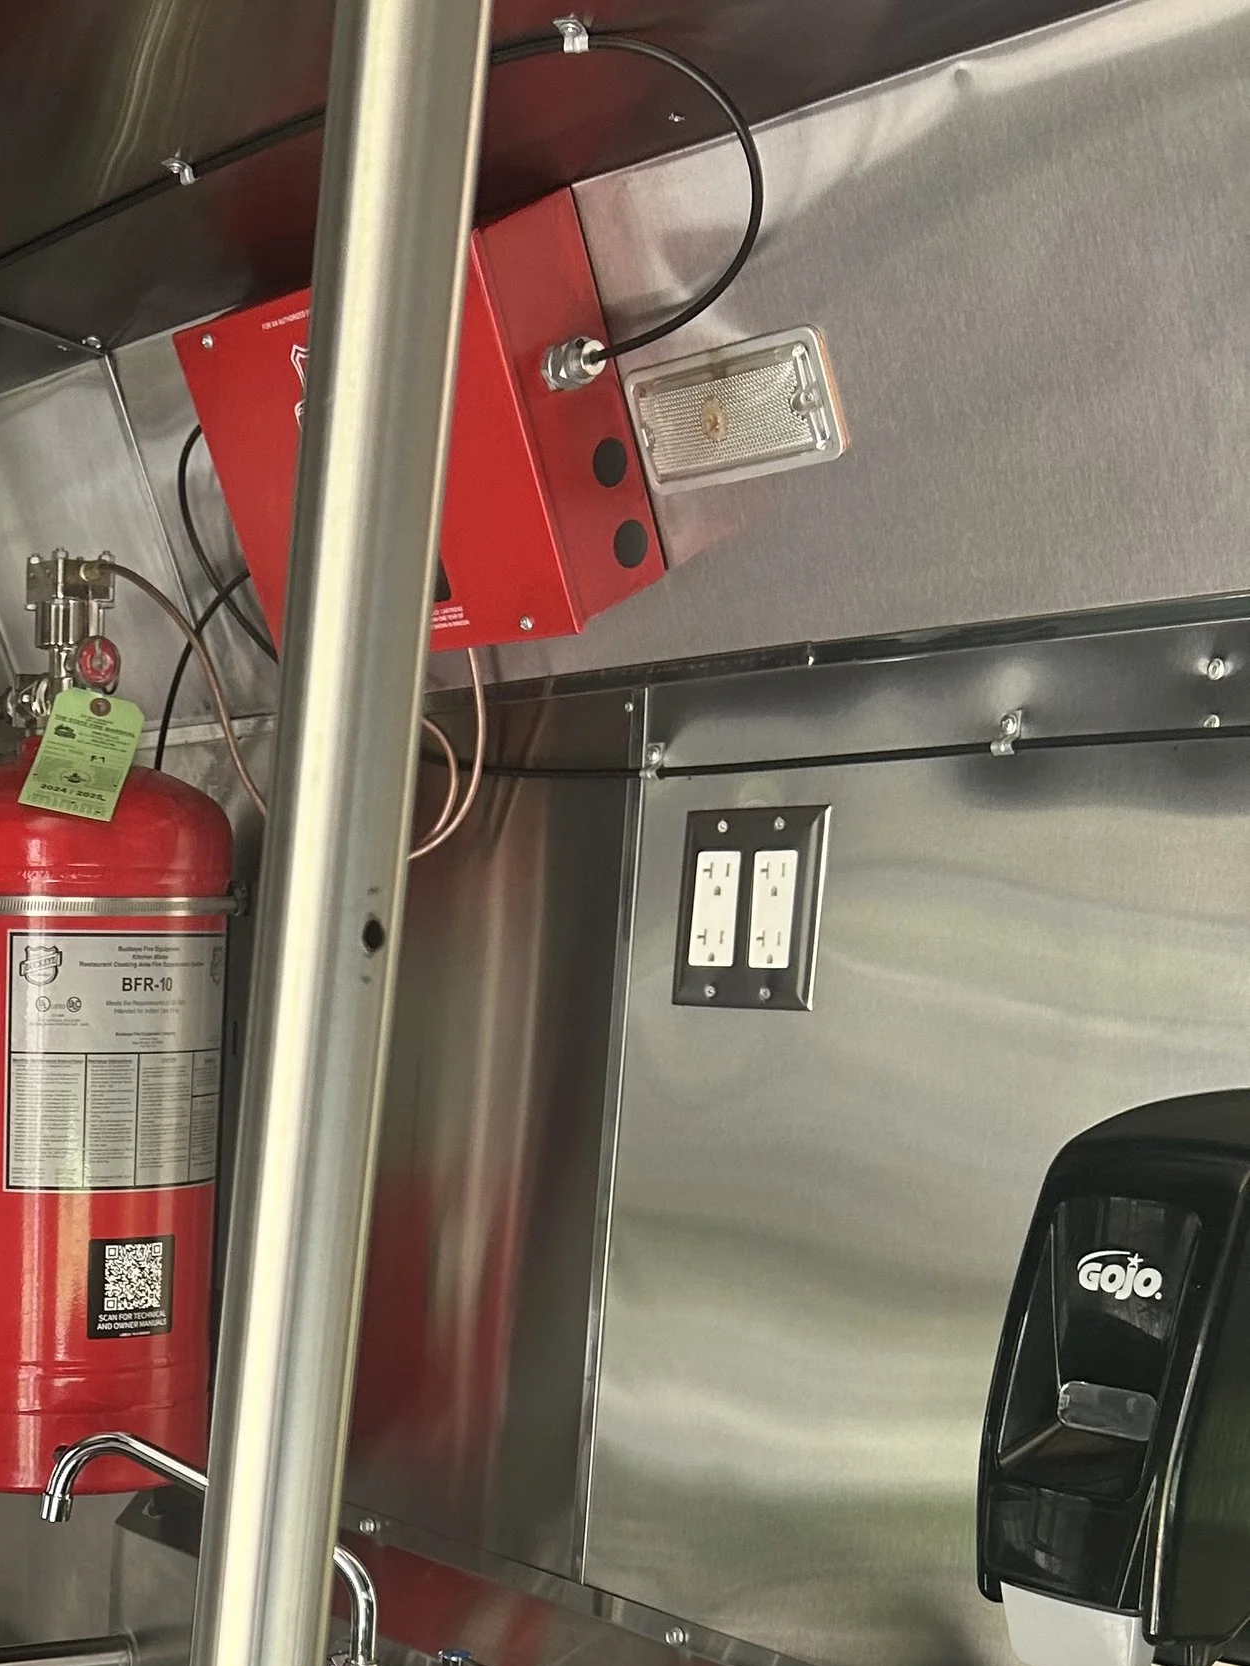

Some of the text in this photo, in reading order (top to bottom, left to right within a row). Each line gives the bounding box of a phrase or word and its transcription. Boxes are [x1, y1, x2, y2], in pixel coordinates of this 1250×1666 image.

[40, 783, 67, 794] 2024
[113, 961, 137, 969] Cooking
[121, 976, 174, 993] BFR-10
[1078, 1256, 1163, 1301] GOJO
[98, 1314, 117, 1322] SCAN
[134, 1311, 166, 1319] TECHNICAL
[113, 1321, 138, 1329] OWNER
[139, 1318, 167, 1327] MANUALS
